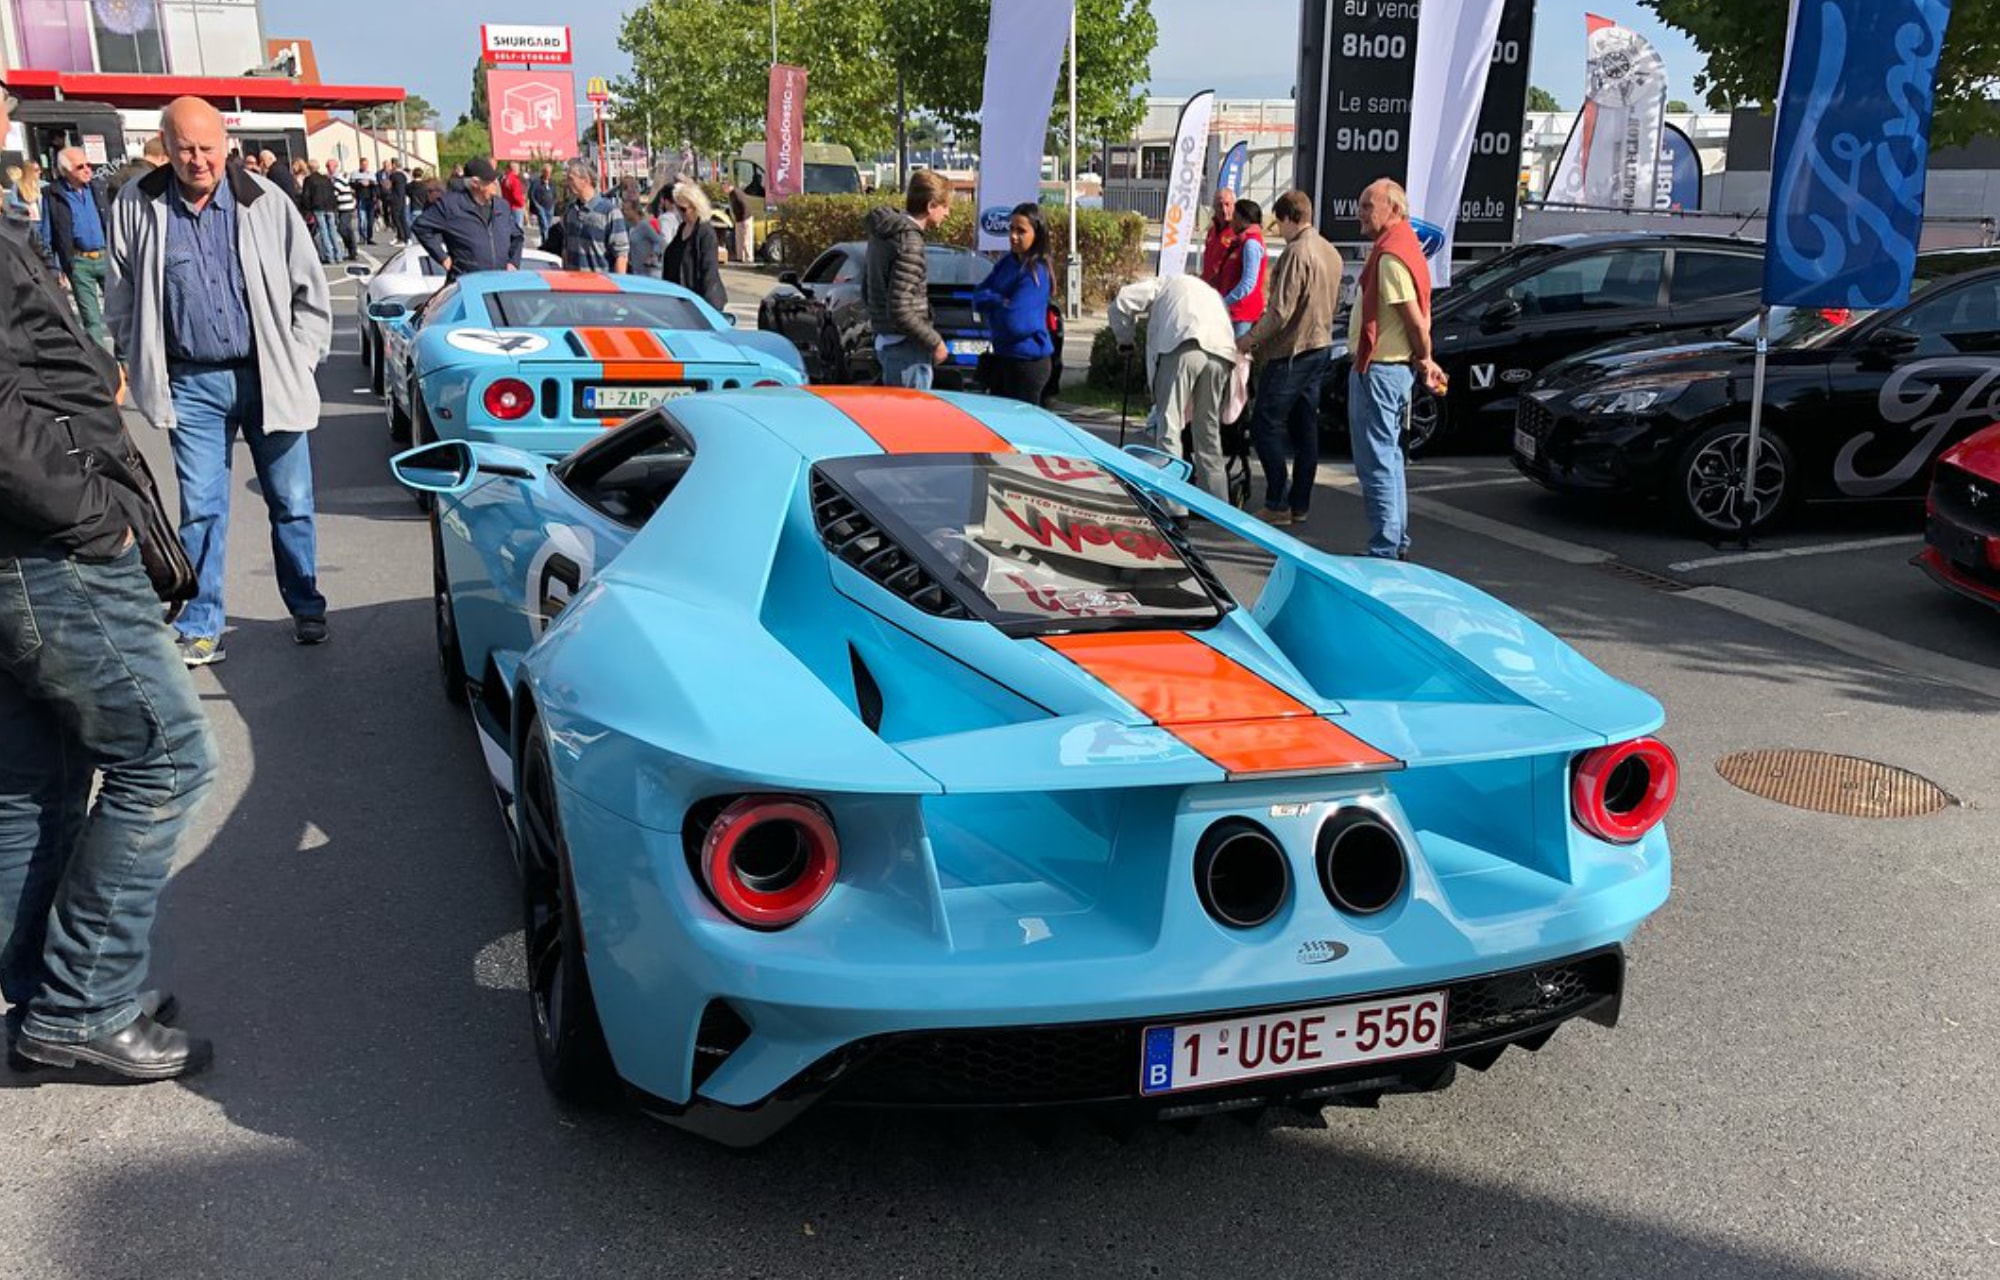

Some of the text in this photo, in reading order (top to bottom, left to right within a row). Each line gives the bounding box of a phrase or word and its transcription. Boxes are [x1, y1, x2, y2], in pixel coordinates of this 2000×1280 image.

[1344, 0, 1367, 17] au
[493, 36, 561, 48] SHURGARD
[1342, 33, 1519, 64] 8h00 00
[494, 53, 562, 62] SELF-STORAGE
[1338, 90, 1361, 112] Le
[1336, 128, 1400, 151] 9h00
[1461, 196, 1505, 222] ge.be
[455, 332, 533, 352] 4
[1184, 1000, 1438, 1078] 1-UGE-556
[1150, 1064, 1168, 1086] B
